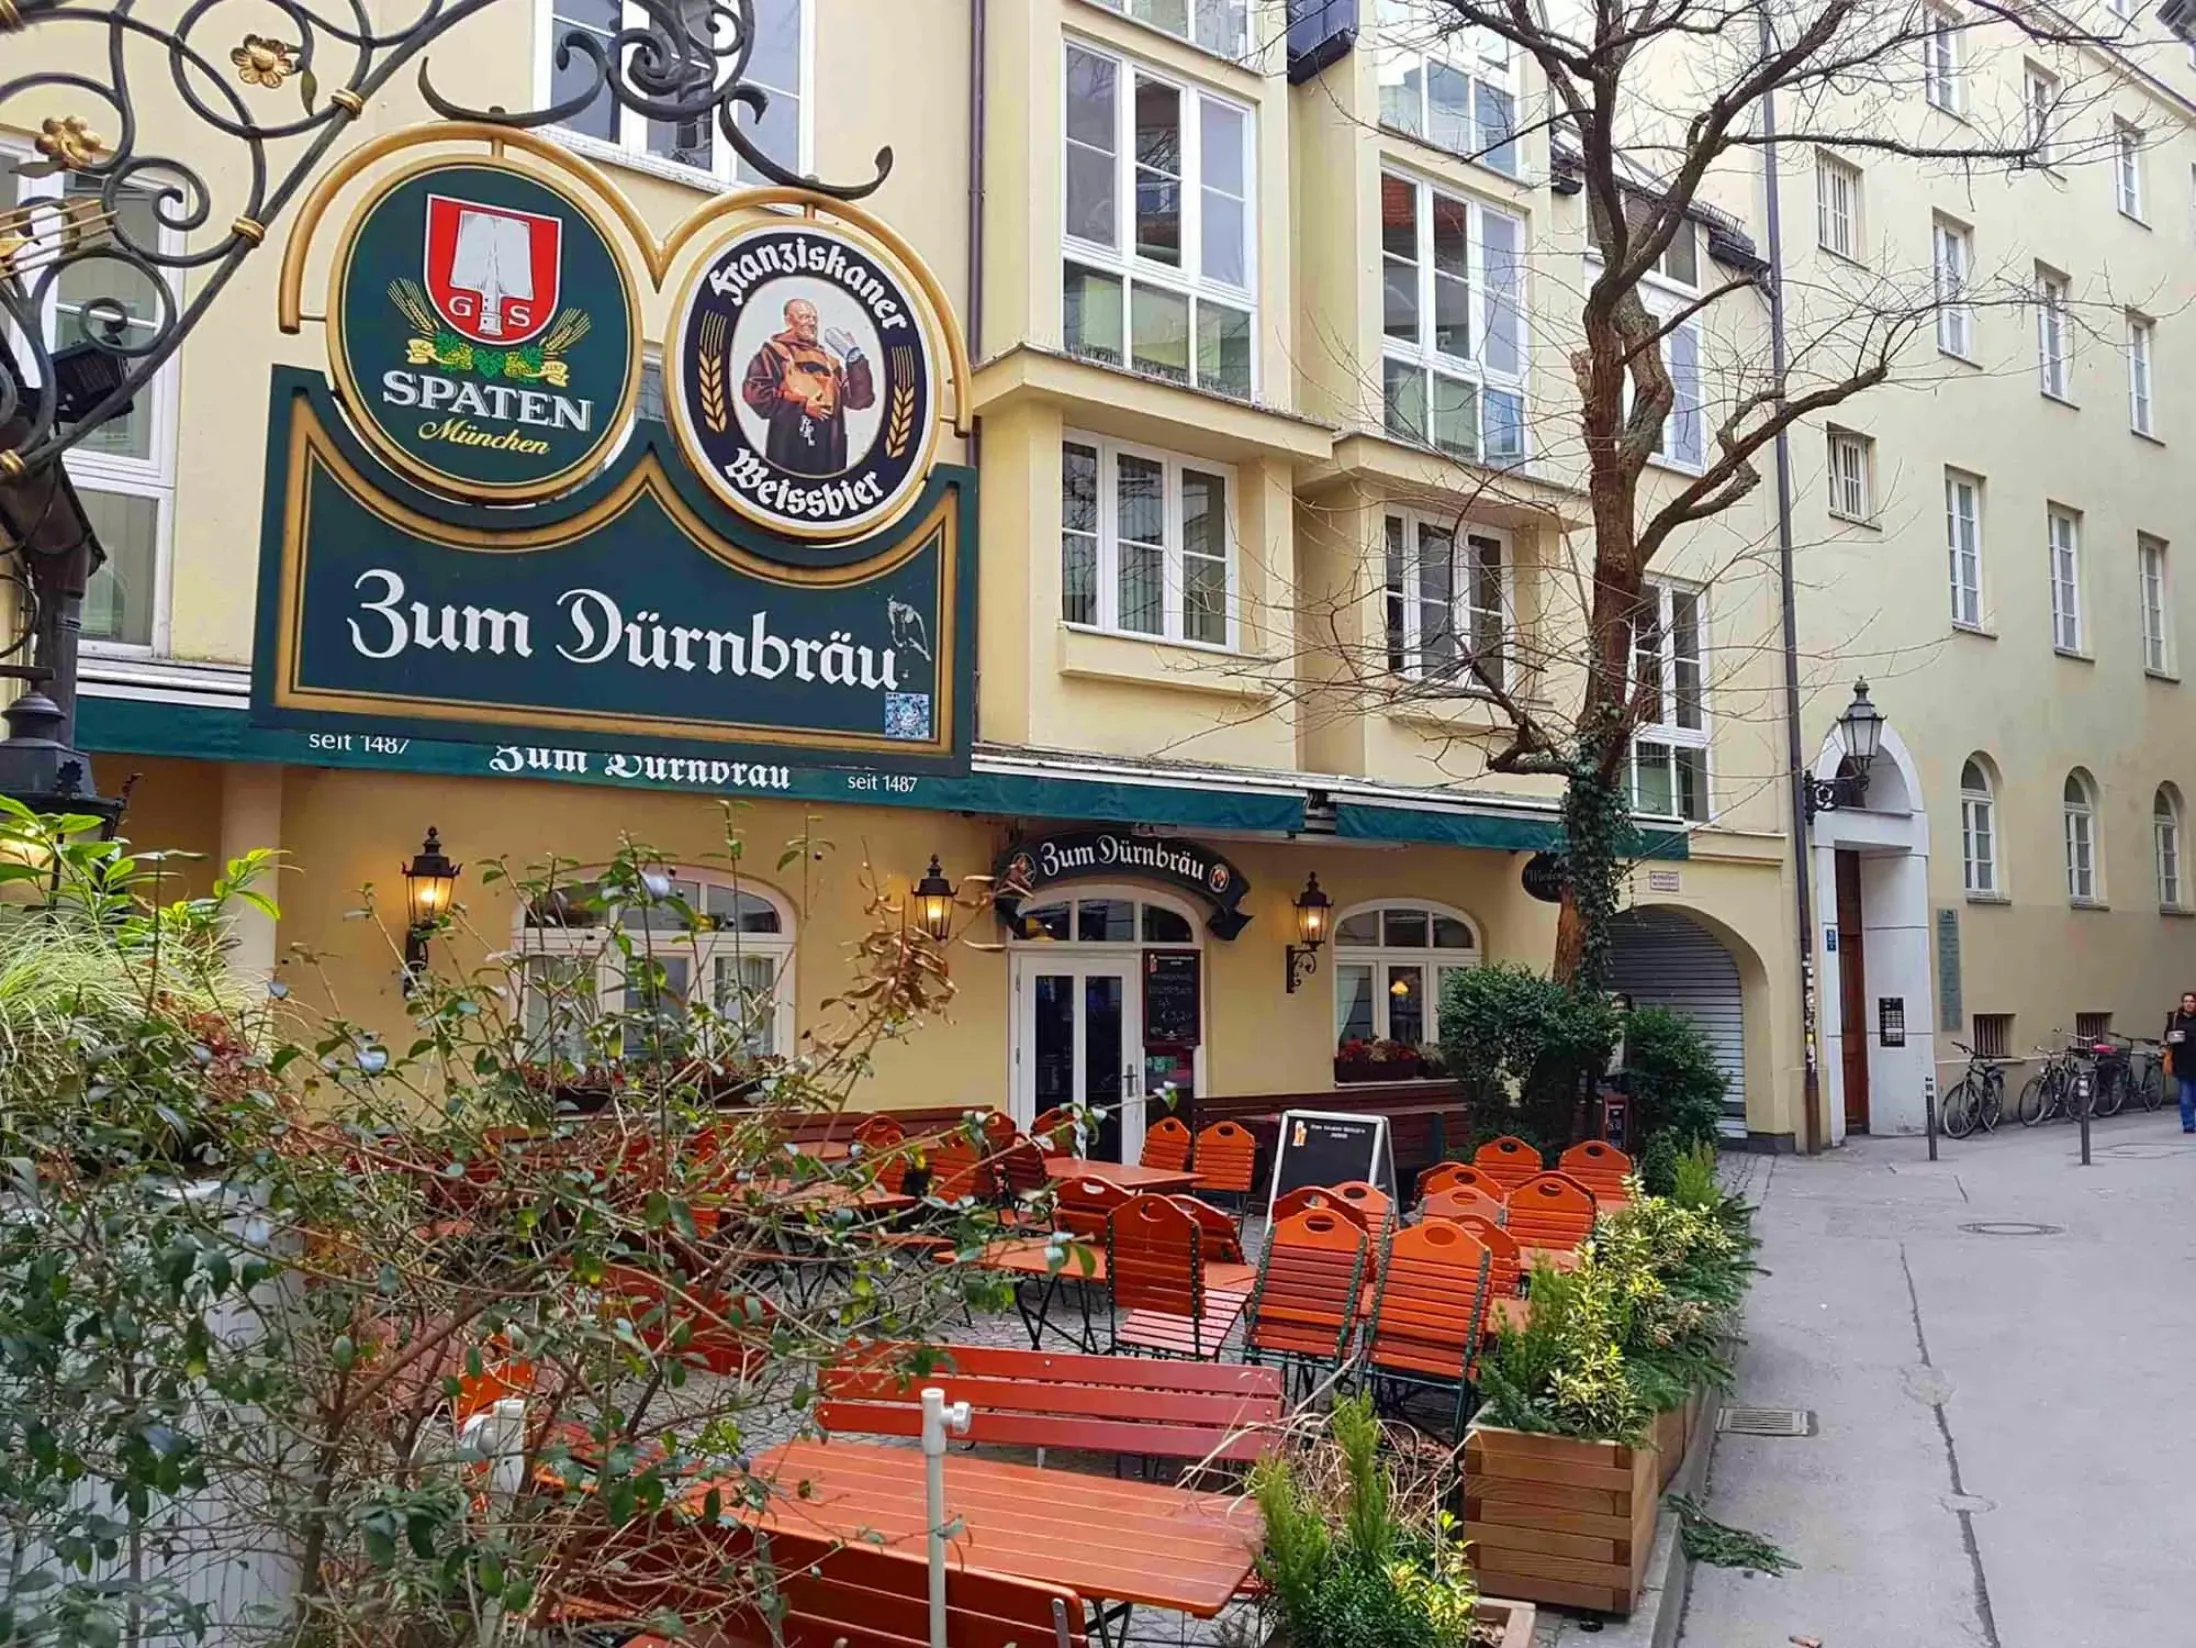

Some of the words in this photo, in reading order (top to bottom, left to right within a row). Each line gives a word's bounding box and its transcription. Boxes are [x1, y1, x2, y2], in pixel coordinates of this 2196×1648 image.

[709, 237, 908, 330] Franziskaner
[449, 295, 474, 317] G
[507, 304, 532, 328] S
[383, 369, 595, 432] SPATEN
[418, 418, 550, 455] München
[724, 447, 884, 518] Weissbier
[346, 568, 533, 659] Zum
[555, 587, 898, 691] Dürnbräu
[308, 732, 352, 751] seit
[847, 775, 878, 791] seit
[882, 775, 918, 793] 1487
[1040, 841, 1096, 877] Zum
[1096, 834, 1205, 881] Dürnbräu
